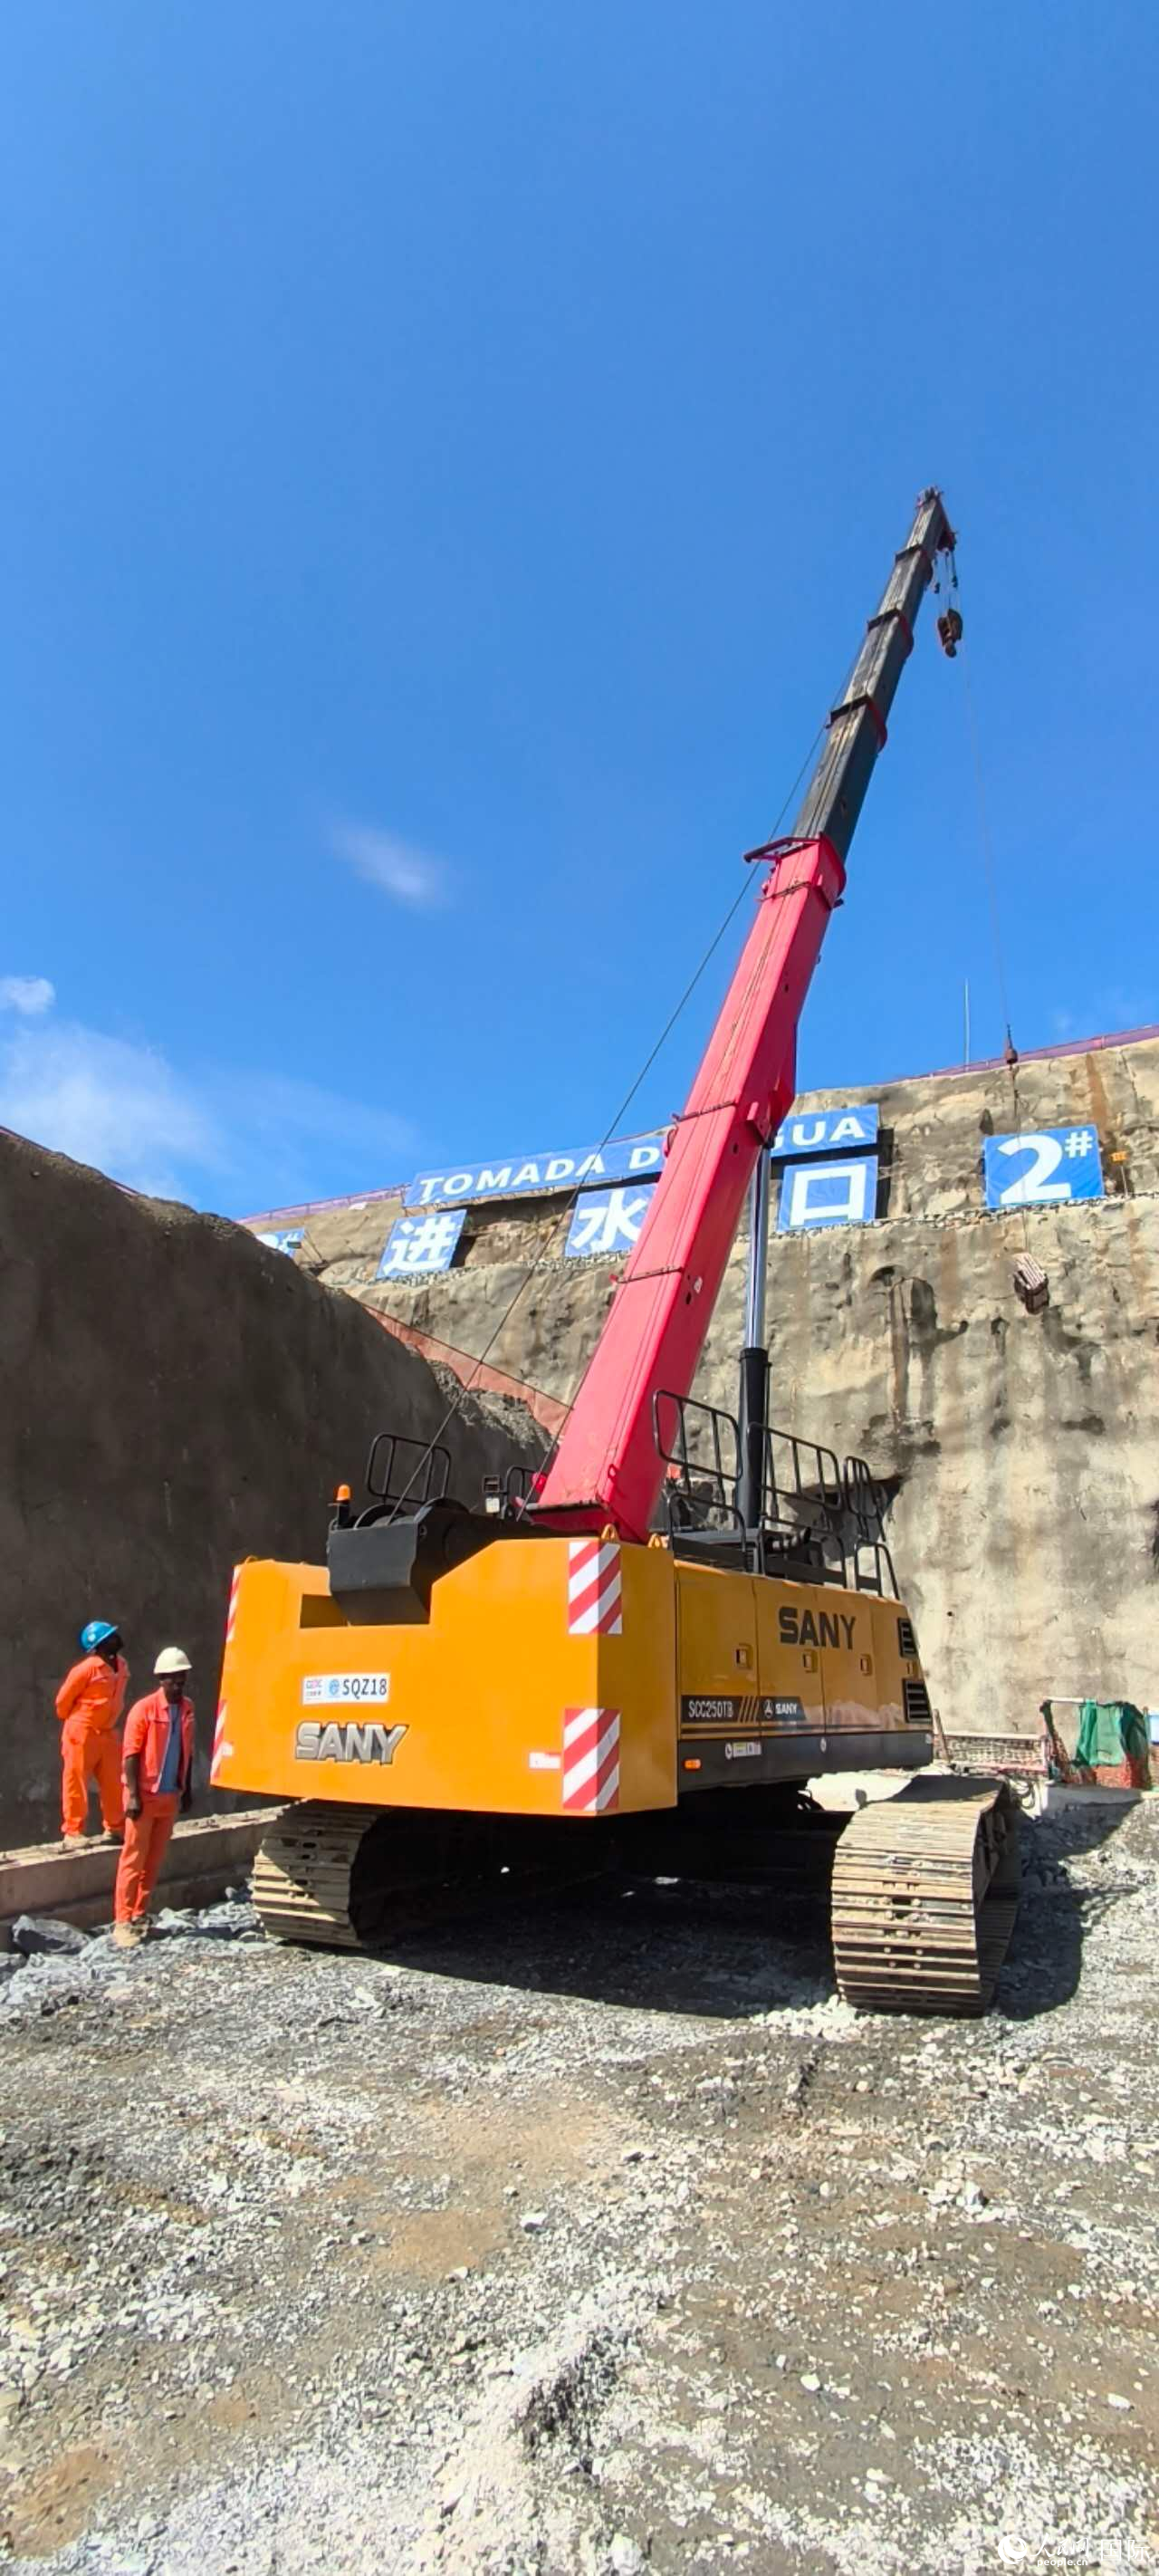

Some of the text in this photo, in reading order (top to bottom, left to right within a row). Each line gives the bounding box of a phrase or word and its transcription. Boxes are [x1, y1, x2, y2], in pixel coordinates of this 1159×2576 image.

[419, 1153, 605, 1205] TOMADA
[997, 1129, 1093, 1205] 2#
[779, 1606, 857, 1649] SANY
[342, 1678, 388, 1699] SQZ18
[688, 1700, 734, 1718] SCC250TB
[775, 1703, 798, 1715] SANY
[295, 1722, 409, 1765] SANY
